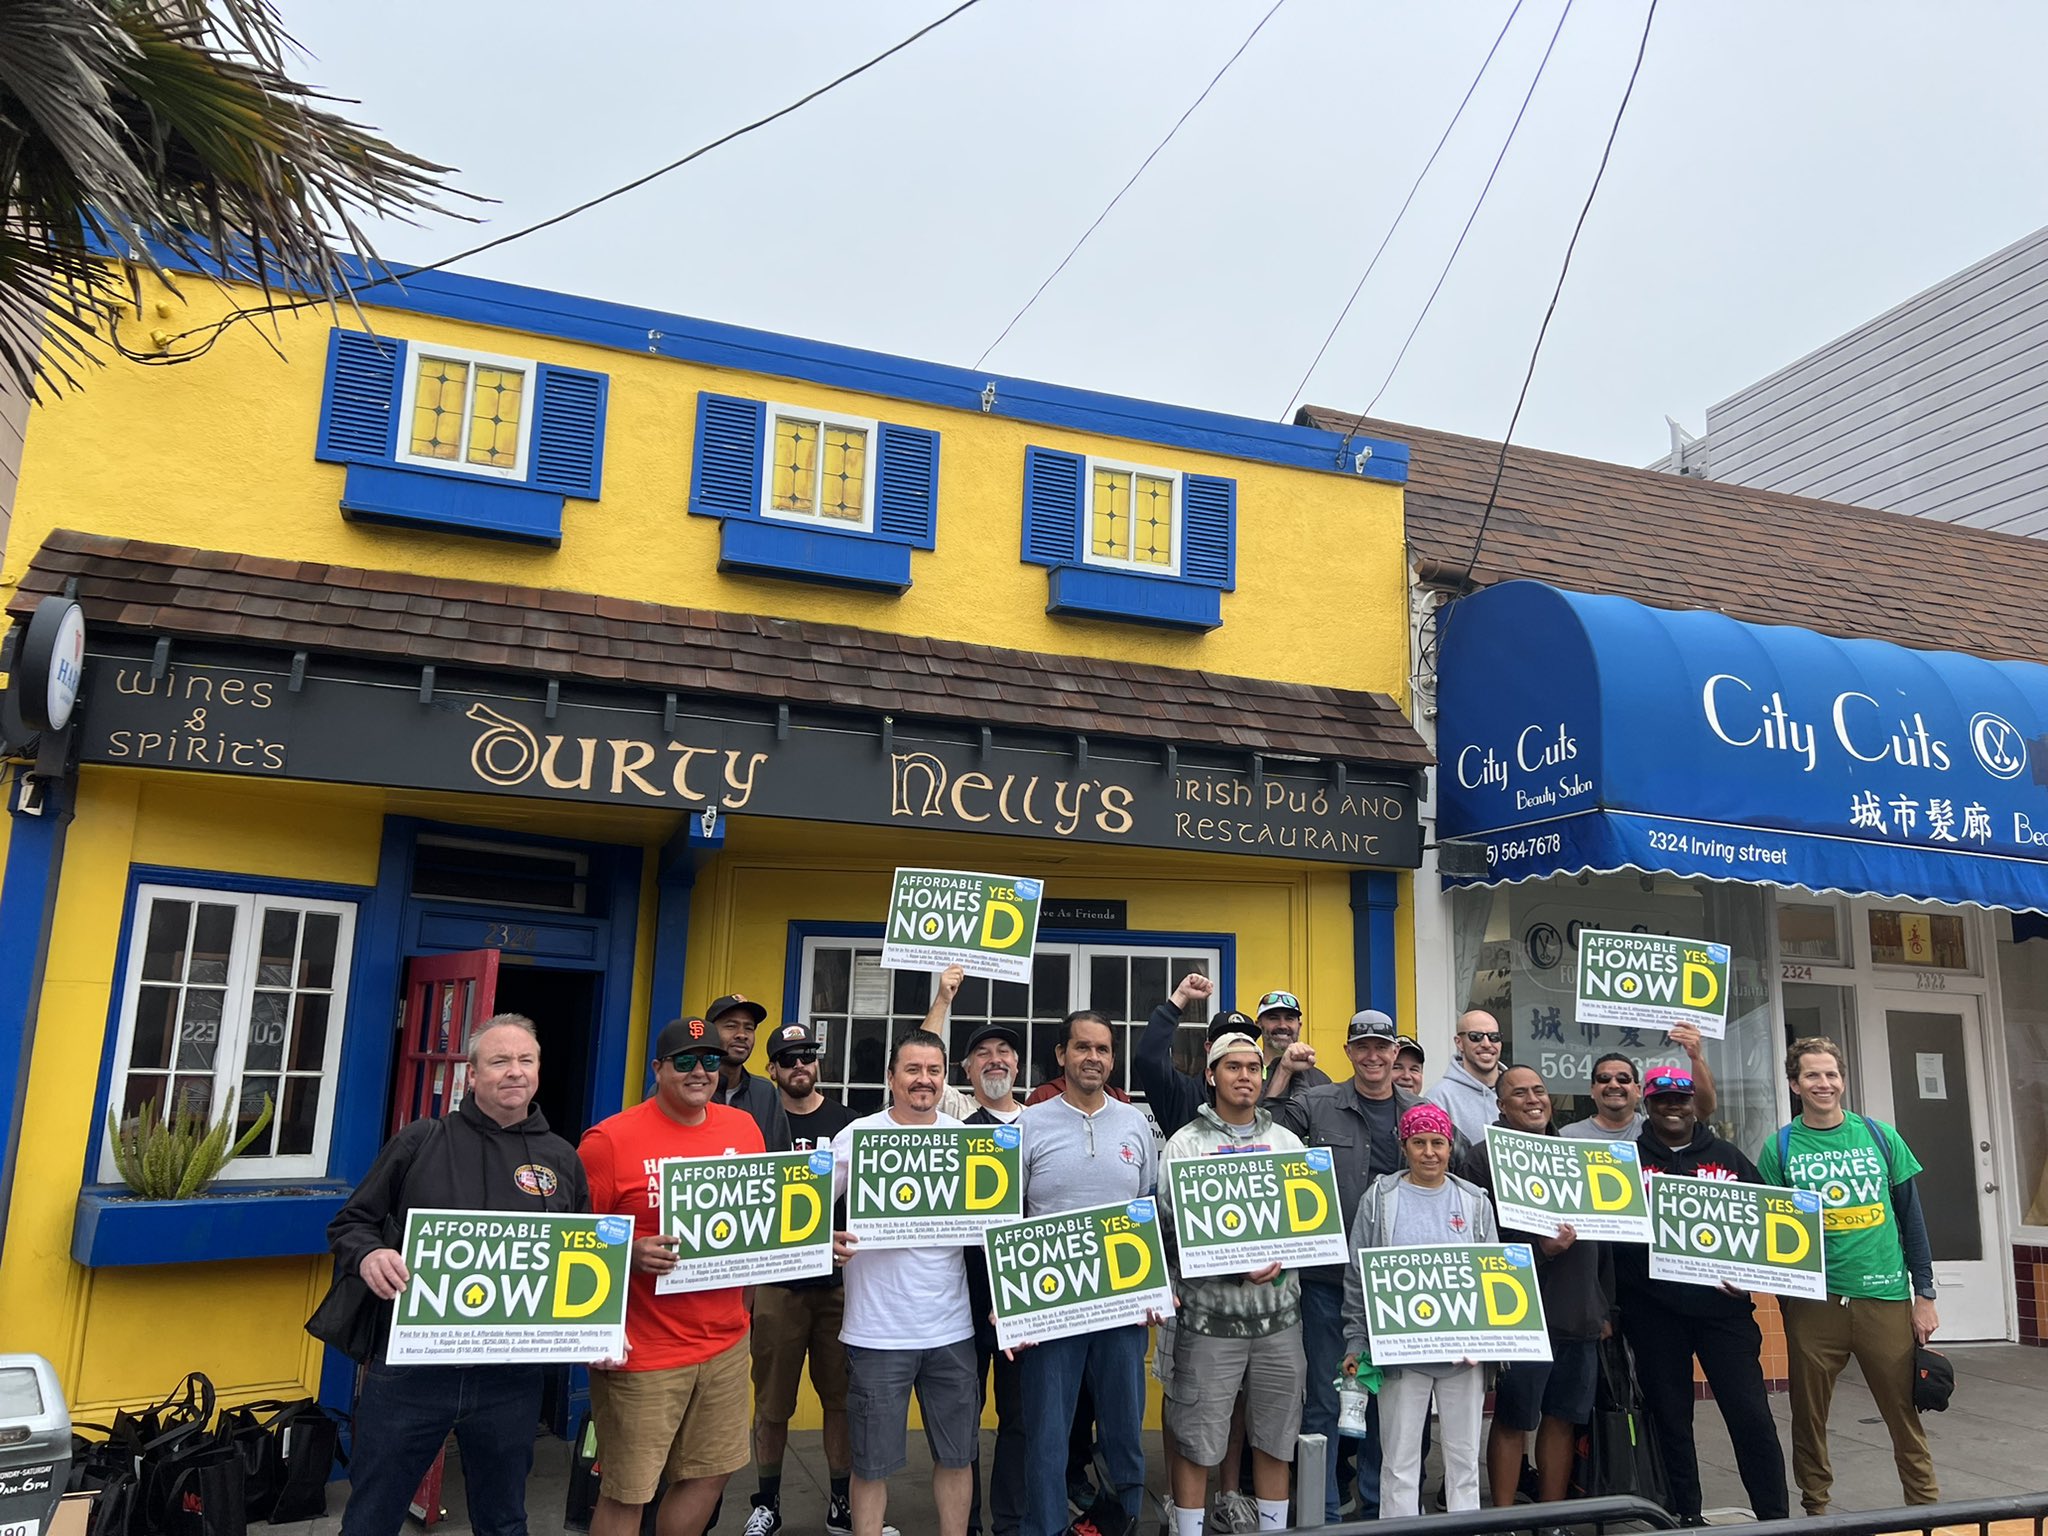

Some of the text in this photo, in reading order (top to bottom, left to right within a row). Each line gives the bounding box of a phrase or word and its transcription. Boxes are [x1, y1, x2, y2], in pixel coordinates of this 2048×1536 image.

[184, 708, 207, 731] &
[1702, 674, 1951, 772] City Cuts
[1458, 723, 1577, 791] City Cuts
[1517, 774, 1592, 810] Beauty Salon
[1501, 834, 1560, 861] 564-7678
[1649, 831, 1787, 865] 2324 Irving street
[901, 876, 982, 890] AFFORDABLE
[990, 887, 1014, 901] YES
[898, 888, 981, 912] HOMES
[894, 910, 978, 944] NOW
[980, 901, 1024, 950] D
[1587, 948, 1678, 973] HOMES
[1588, 937, 1676, 954] AFFORDABLE
[1684, 950, 1710, 964] YES
[1586, 969, 1678, 1002] NOW
[1682, 962, 1718, 1007] D
[1782, 966, 1812, 980] 2324
[860, 1134, 958, 1147] AFFORDABLE
[967, 1138, 994, 1153] YES
[1494, 1134, 1577, 1156] AFFORDABLE
[1790, 1147, 1874, 1164] AFFORDABLE
[671, 1162, 775, 1182] AFFORDABLE
[859, 1148, 959, 1174] HOMES
[1179, 1160, 1274, 1179] AFFORDABLE
[1282, 1162, 1310, 1177] YES
[1494, 1146, 1582, 1178] HOMES
[1584, 1150, 1612, 1164] YES
[1790, 1157, 1881, 1182] HOMES
[784, 1165, 810, 1182] YES
[965, 1155, 1008, 1210] D
[1586, 1164, 1632, 1210] D
[672, 1178, 776, 1212] HOMES
[858, 1176, 959, 1212] NOW
[1180, 1174, 1279, 1204] HOMES
[1499, 1168, 1583, 1210] NOW
[1658, 1182, 1757, 1202] AFFORDABLE
[780, 1183, 822, 1243] D
[1284, 1178, 1328, 1232] D
[1659, 1194, 1759, 1225] HOMES
[1766, 1199, 1794, 1215] YES
[1844, 1214, 1864, 1224] ON
[418, 1221, 551, 1238] AFFORDABLE
[670, 1207, 776, 1255] NOW
[994, 1216, 1092, 1246] AFFORDABLE
[1102, 1216, 1130, 1233] YES
[1184, 1200, 1280, 1241] NOW
[562, 1231, 597, 1249] YES
[996, 1231, 1098, 1272] HOMES
[1660, 1218, 1760, 1258] NOW
[1766, 1212, 1810, 1264] D
[414, 1239, 550, 1270] HOMES
[1104, 1232, 1151, 1291] D
[408, 1273, 548, 1317] NOW
[552, 1250, 612, 1320] D
[1000, 1258, 1100, 1310] NOW
